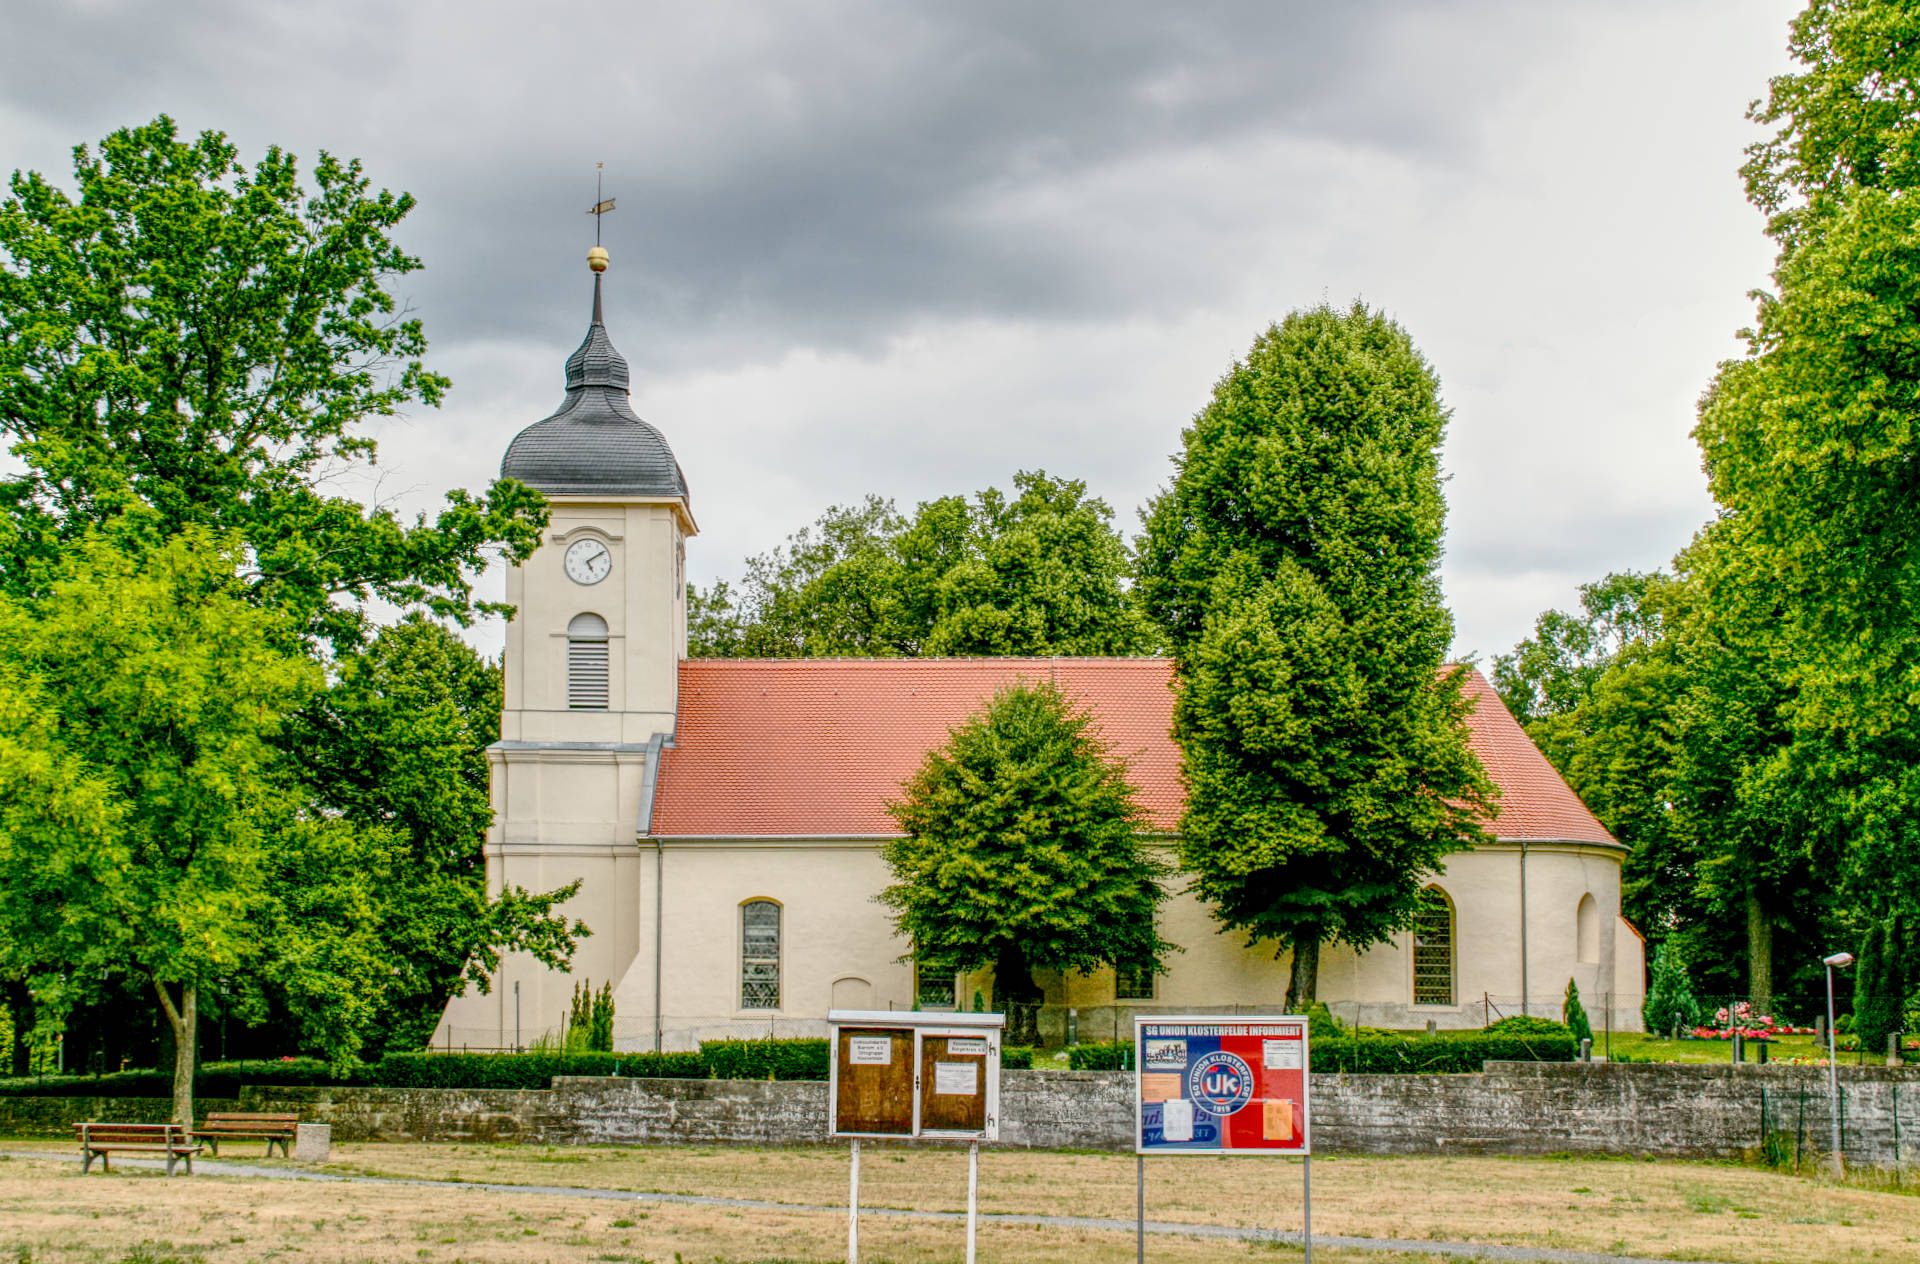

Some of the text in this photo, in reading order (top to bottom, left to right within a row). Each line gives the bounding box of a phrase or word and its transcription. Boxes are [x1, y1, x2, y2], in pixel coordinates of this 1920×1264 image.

[1146, 1025, 1301, 1036] SG UNION KLOSTERFELDE INFORMIERT
[1192, 1059, 1210, 1082] UNION
[1210, 1055, 1250, 1097] KLOSTERFELDE
[1206, 1074, 1238, 1095] UK
